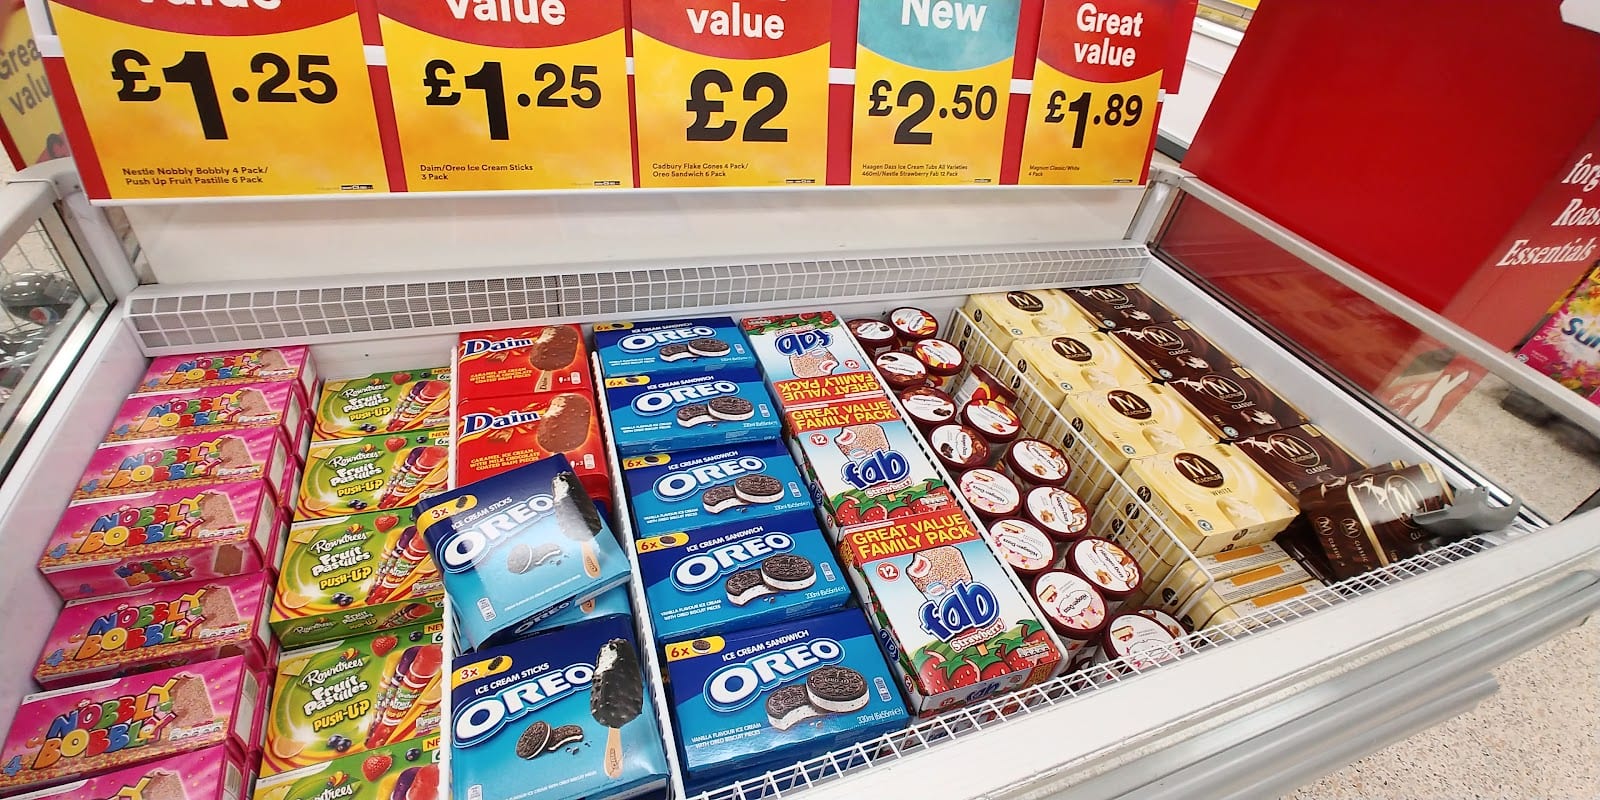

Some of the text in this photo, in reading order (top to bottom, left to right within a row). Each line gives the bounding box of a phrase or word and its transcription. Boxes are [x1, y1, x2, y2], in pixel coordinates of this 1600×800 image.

[686, 2, 784, 39] value
[901, 0, 987, 31] New
[1076, 3, 1143, 37] Great
[0, 38, 41, 80] Grea
[1073, 38, 1136, 67] value
[9, 73, 51, 115] valu
[111, 49, 338, 139] £1.25
[423, 60, 601, 140] £1.25
[686, 69, 788, 142] £2
[868, 79, 998, 144] £2.50
[1044, 90, 1143, 148] £1.89
[126, 176, 263, 186] Push Up Fruit Pastille 6 Pack
[157, 167, 193, 177] Nobbly
[196, 167, 229, 176] Bobbly
[232, 167, 239, 175] 4
[420, 164, 466, 172] Daim/Oreo
[652, 163, 682, 171] Cadbury
[1561, 153, 1600, 192] forg
[1551, 198, 1600, 226] Roas
[1497, 237, 1596, 266] Essentials
[464, 337, 532, 358] Daim
[621, 326, 714, 351] OREO
[776, 330, 833, 355] fab
[166, 364, 264, 385] BOBBLY
[175, 350, 262, 373] NOBBLY
[609, 380, 623, 388] 6x
[635, 380, 737, 412] OREO
[778, 372, 875, 394] FAMILY PACK
[785, 382, 880, 401] GREAT VALUE
[149, 389, 242, 417] NOBBLY
[349, 407, 391, 421] PUSH-UP
[791, 401, 890, 422] GREAT VALUE
[137, 407, 243, 432] BOBBLY
[464, 410, 541, 437] Daim
[796, 414, 850, 431] FAMILY
[855, 408, 896, 423] PACK
[120, 437, 221, 469] NOBBLY
[812, 434, 826, 445] 12
[106, 456, 222, 489] BOBBLY
[336, 463, 375, 478] Fruit
[627, 459, 642, 468] 6x
[668, 450, 739, 471] ICE CREAM SANDWICH
[843, 450, 908, 488] fab
[337, 479, 384, 497] PUSH-UP
[657, 456, 763, 496] OREO
[865, 478, 912, 497] Strawberry
[93, 493, 206, 532] NOBBLY
[431, 508, 449, 519] 3x
[451, 496, 513, 531] ICE CREAM STICKS
[76, 518, 206, 554] BOBBLY
[444, 495, 554, 568] OREO
[687, 526, 764, 553] ICE CREAM SANDWICH
[853, 513, 966, 545] GREAT VALUE
[859, 525, 976, 560] FAMILY PACK
[319, 546, 363, 567] Fruit
[641, 541, 657, 551] 6x
[676, 534, 792, 585] OREO
[312, 551, 371, 577] Pastilles
[320, 566, 373, 590] PUSH-UP
[878, 565, 897, 578] 12
[87, 588, 207, 635] NOBBLY
[919, 581, 999, 641] fab
[72, 615, 206, 661] BOBBLY
[721, 629, 810, 662] ICE CREAM SANDWICH
[951, 619, 1005, 652] Strawberry
[46, 649, 65, 667] 4
[671, 647, 689, 658] 6x
[460, 668, 478, 680] 3x
[475, 662, 550, 696] ICE CREAM STICKS
[710, 639, 840, 704] OREO
[303, 680, 369, 716] Pastilles
[311, 674, 359, 701] Fruit
[46, 678, 178, 739] NOBBLY
[313, 699, 371, 732] PUSH-UP
[456, 665, 595, 740] OREO
[31, 712, 177, 770] BOBBLY
[3, 754, 23, 778] 4
